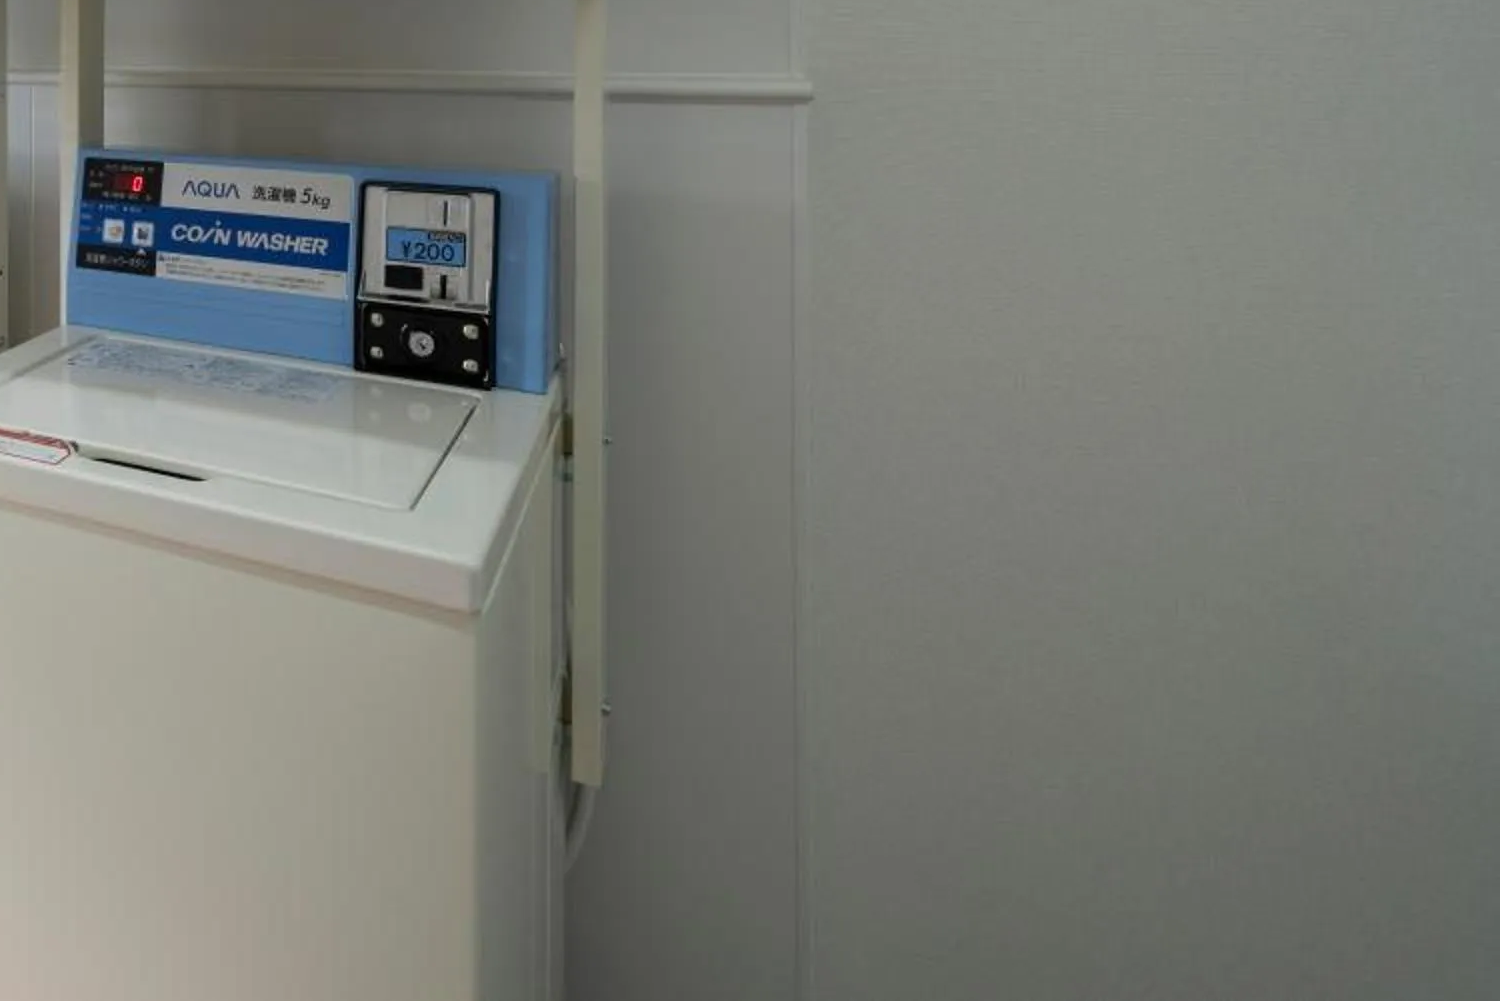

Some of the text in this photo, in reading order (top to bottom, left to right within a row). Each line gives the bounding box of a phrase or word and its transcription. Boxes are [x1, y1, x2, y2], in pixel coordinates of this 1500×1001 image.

[132, 176, 143, 192] 0
[182, 180, 331, 210] AQUA 洗濯機 5kg
[237, 229, 329, 256] WASHER
[402, 240, 455, 262] ¥200
